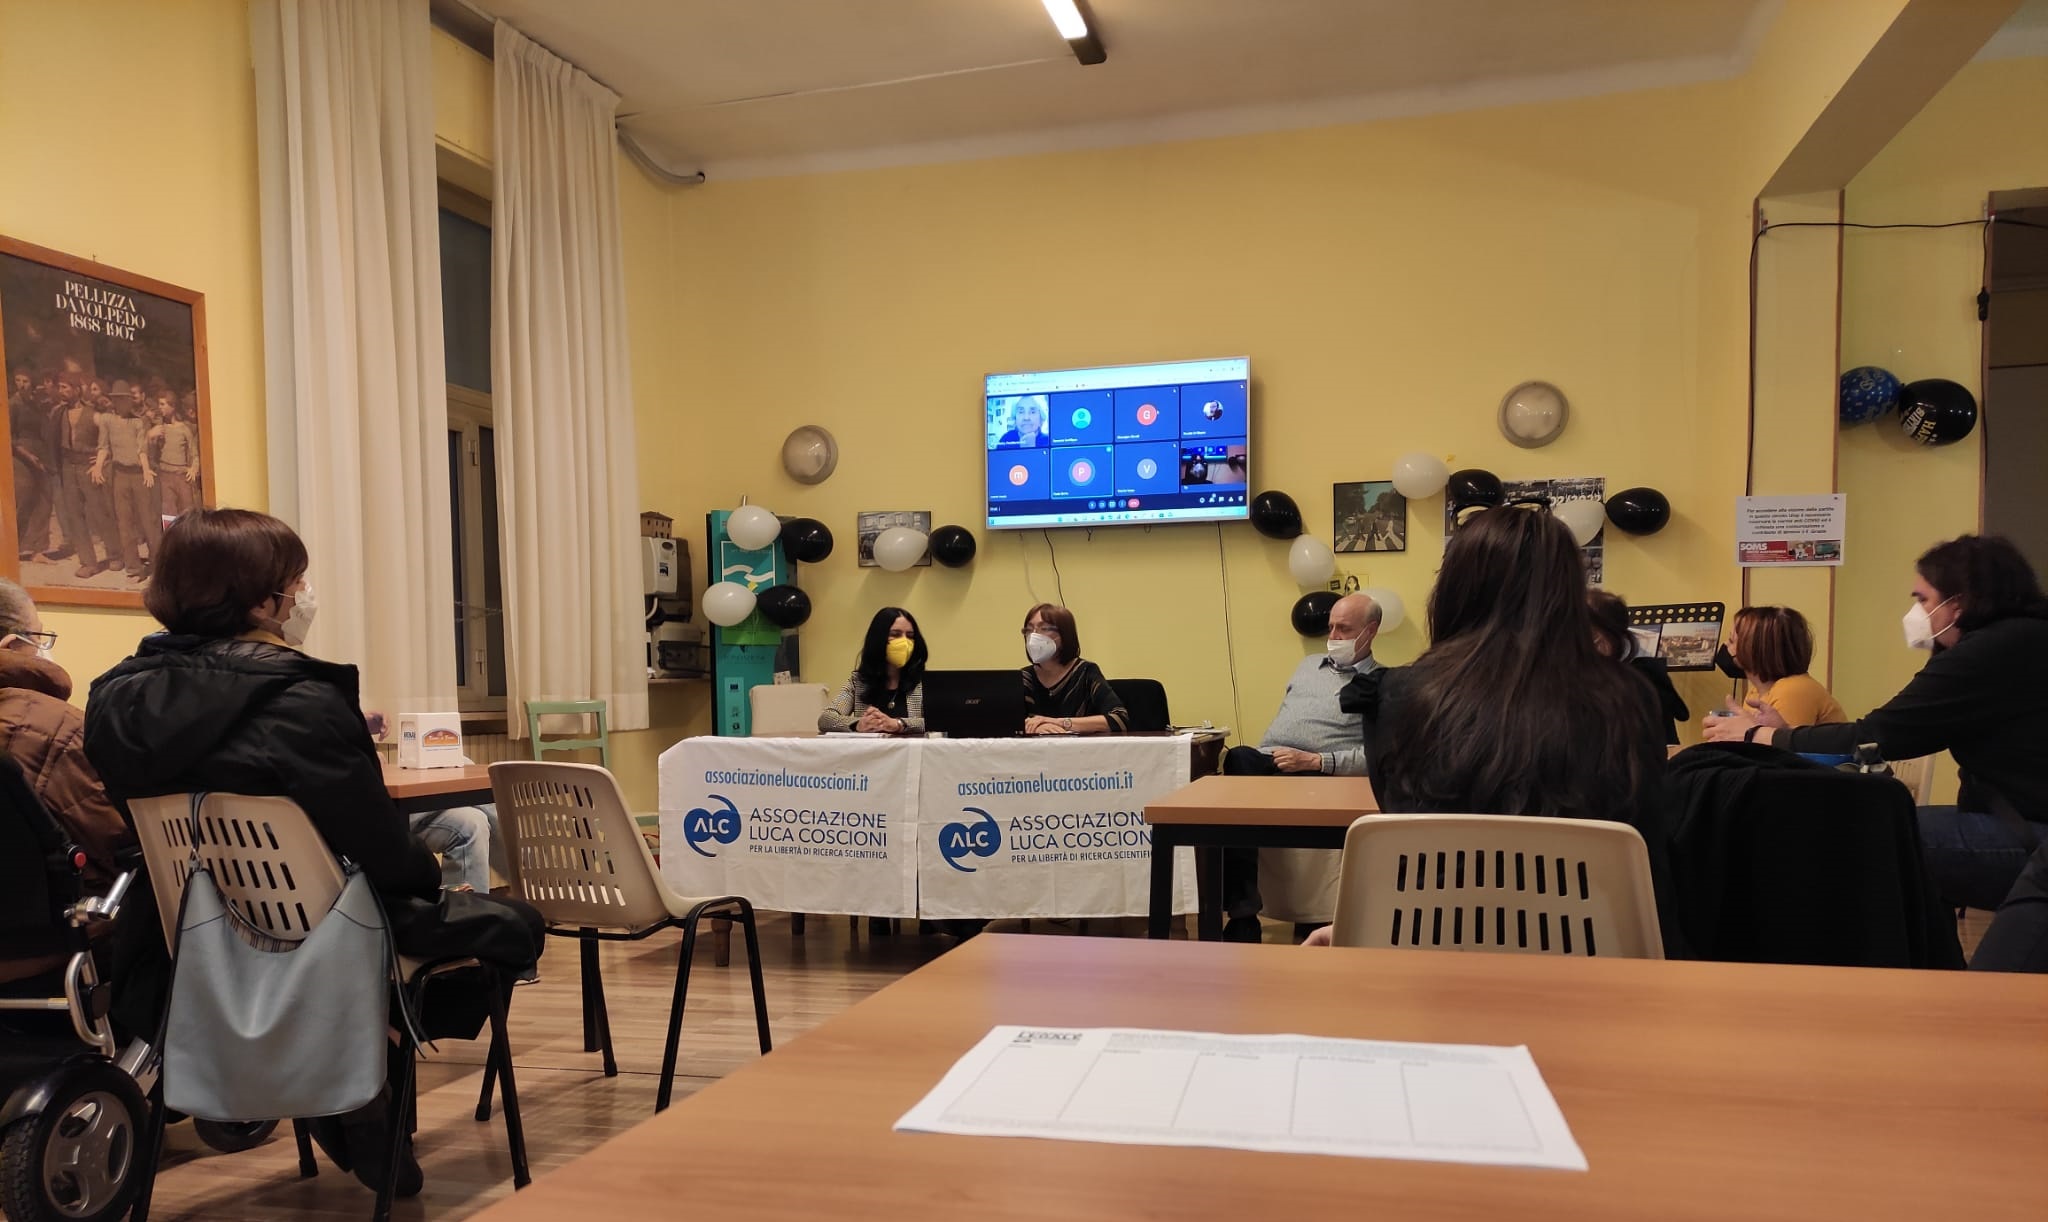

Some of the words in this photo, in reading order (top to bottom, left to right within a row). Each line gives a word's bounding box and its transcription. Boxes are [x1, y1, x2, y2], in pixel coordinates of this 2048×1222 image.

[65, 281, 136, 313] PELLIZZA
[1740, 542, 1768, 551] SOMS
[705, 767, 869, 792] associazionelucacoscioni.it
[958, 771, 1134, 796] associazionelucacoscioni.it
[693, 817, 730, 835] ALC
[749, 807, 887, 829] ASSOCIAZIONE
[1009, 810, 1144, 832] ASSOCIAZION
[749, 825, 794, 842] LUCA
[798, 828, 887, 847] COSCIONI
[950, 831, 989, 848] ALC
[1010, 833, 1059, 850] LUCA
[1063, 830, 1152, 849] COSCION
[749, 844, 763, 853] PER
[764, 845, 773, 854] LA
[803, 847, 811, 856] DI
[812, 847, 843, 858] RICERCA
[845, 849, 888, 860] SCIENTIFICA
[1012, 854, 1026, 863] PER
[1028, 853, 1038, 862] LA
[1038, 851, 1068, 862] LIBERTÀ
[1069, 852, 1078, 861] DI
[1080, 850, 1113, 861] RICERCA
[1114, 850, 1151, 859] SCIENTIFI
